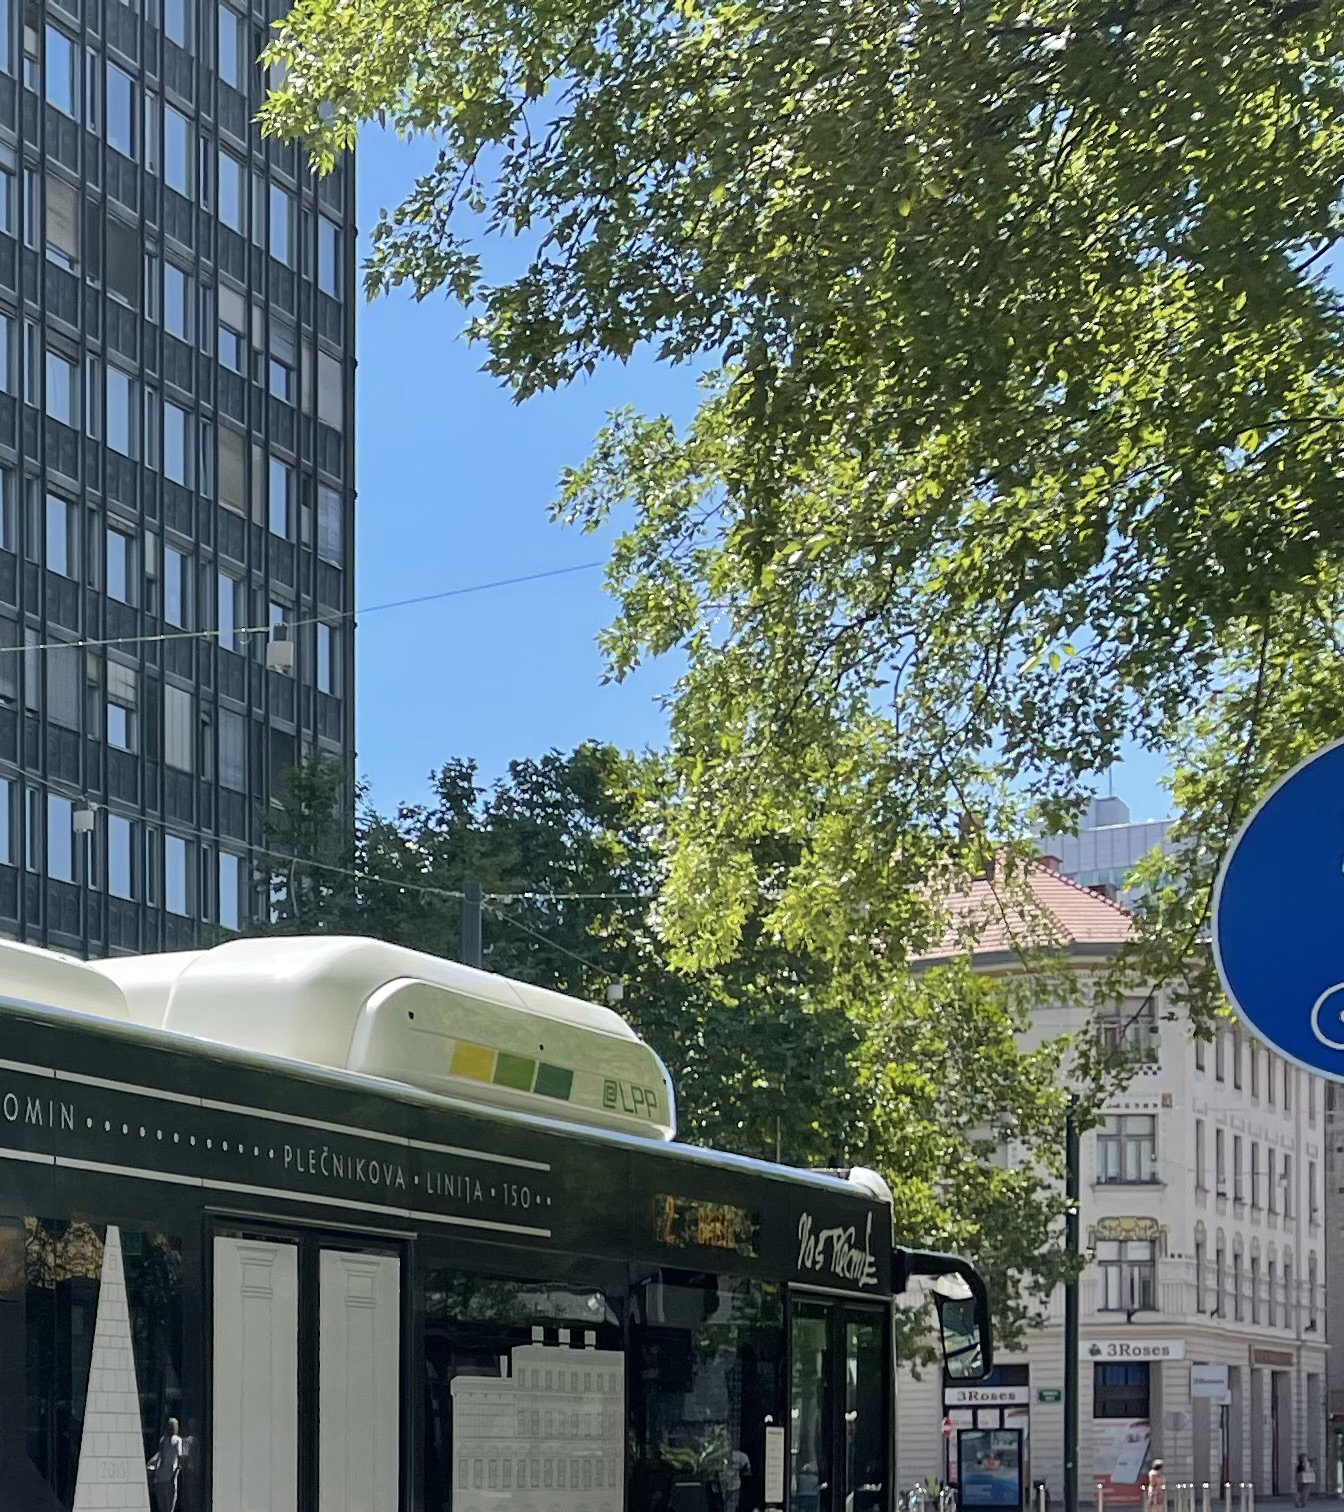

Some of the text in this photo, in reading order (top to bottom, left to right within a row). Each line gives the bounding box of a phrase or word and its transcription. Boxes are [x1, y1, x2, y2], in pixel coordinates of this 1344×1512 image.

[619, 1082, 657, 1118] LPP
[284, 1143, 406, 1189] PLEČNIKOVA
[502, 1184, 532, 1210] 150
[1107, 1343, 1170, 1357] 3Roses
[957, 1389, 1017, 1401] 3Roses
